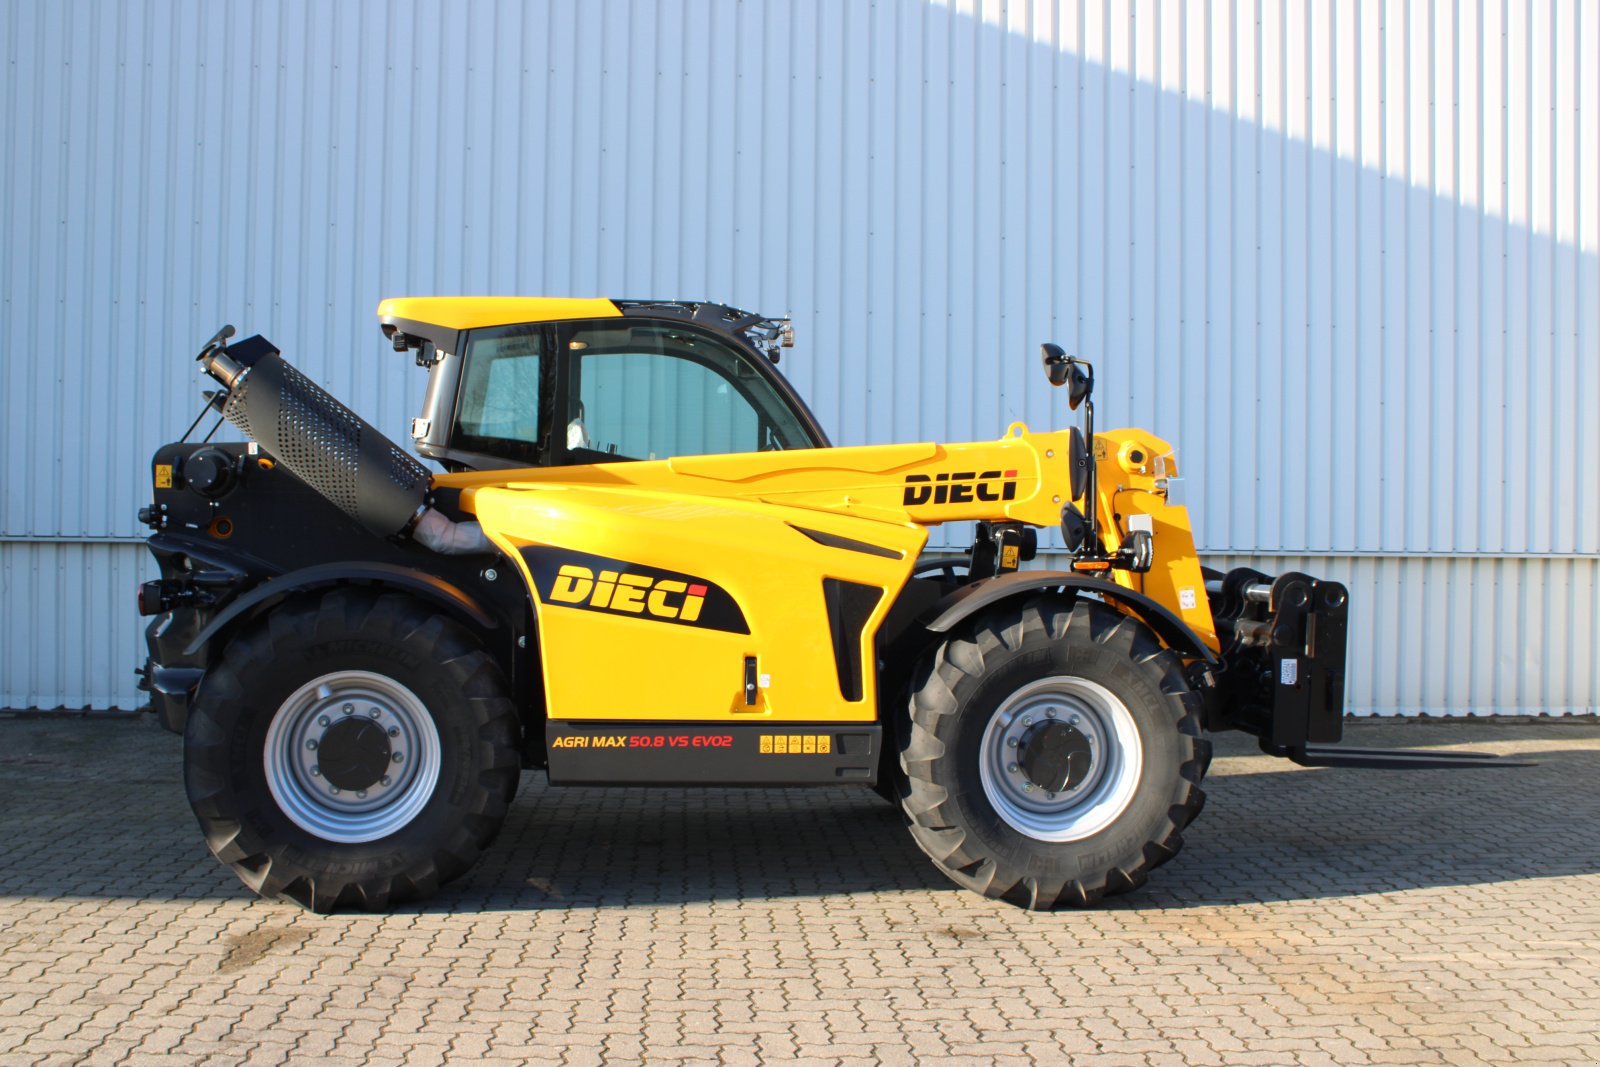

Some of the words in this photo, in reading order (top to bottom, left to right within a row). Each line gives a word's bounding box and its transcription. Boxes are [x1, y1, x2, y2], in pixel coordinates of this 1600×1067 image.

[552, 736, 588, 748] AGRI
[591, 736, 627, 748] MAX
[629, 736, 663, 748] 50.8
[668, 736, 689, 748] VS
[692, 735, 733, 748] EVO2
